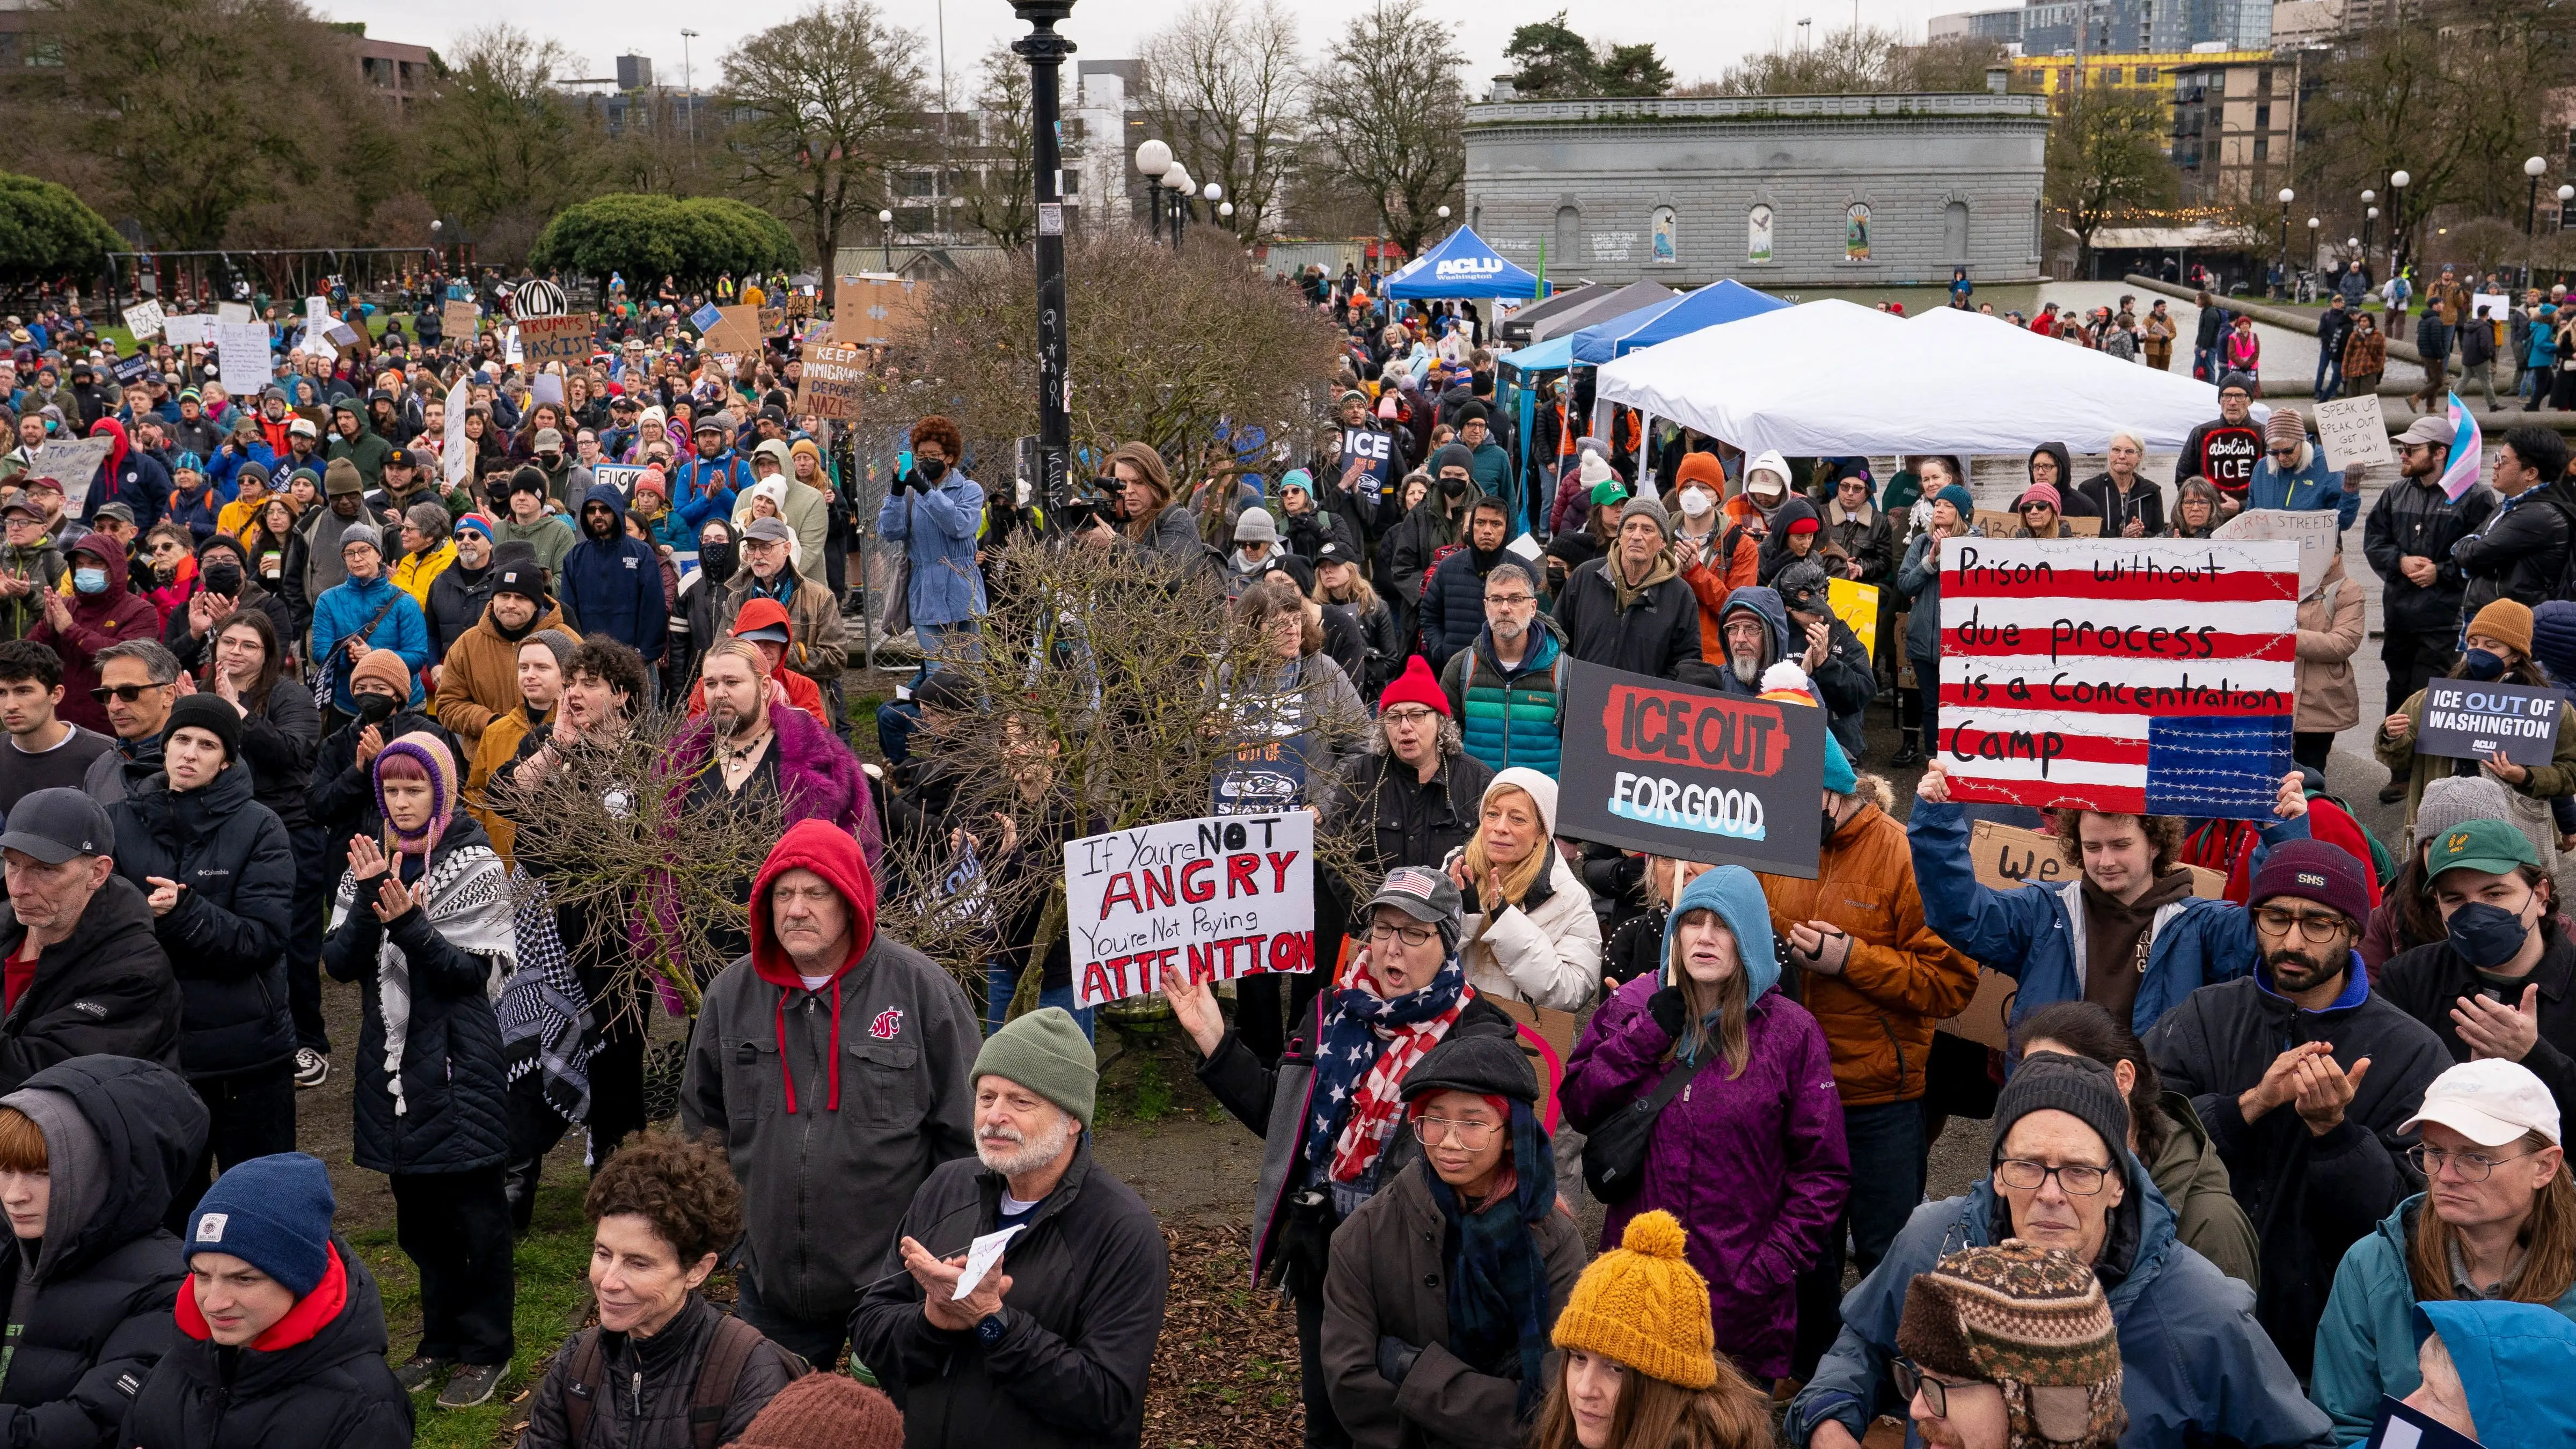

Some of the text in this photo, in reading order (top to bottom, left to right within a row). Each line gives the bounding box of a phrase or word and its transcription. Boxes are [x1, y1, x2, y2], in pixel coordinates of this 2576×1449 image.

[1436, 258, 1503, 275] ACLU
[327, 274, 345, 287] ICE
[514, 281, 565, 317] NOW
[787, 297, 810, 307] FUCK
[788, 306, 807, 316] ICE
[519, 317, 583, 334] TRUMPS
[551, 332, 558, 340] A
[522, 335, 591, 358] FASCIST
[816, 347, 856, 363] KEEP
[2322, 399, 2376, 418] SPEAK UP.
[2320, 416, 2377, 435] SPEAK OUT.
[1345, 430, 1390, 459] ICE
[2209, 437, 2255, 456] abolish
[2339, 433, 2371, 443] GET IN
[2335, 447, 2358, 457] THE
[1368, 460, 1377, 470] OF
[2214, 459, 2251, 479] ICE
[268, 464, 290, 489] UT OF
[2278, 514, 2335, 530] STREETS
[1959, 547, 2226, 587] Prison without
[1957, 603, 2217, 664] due process
[1962, 663, 1989, 701] is
[2007, 676, 2033, 700] a
[323, 688, 332, 704] OF
[2433, 690, 2555, 716] ICE OUT OF
[1620, 692, 1777, 772] ICE OUT
[2429, 711, 2550, 739] WASHINGTON
[1265, 742, 1282, 762] OF
[1951, 719, 2065, 780] Camp
[2472, 740, 2497, 750] ACLU
[1613, 771, 1765, 835] FOR GOOD
[1082, 836, 1118, 876] If
[1198, 818, 1281, 858] NOT
[1999, 845, 2060, 882] We
[1100, 850, 1299, 921] ANGRY
[2298, 874, 2324, 886] SNS
[1843, 900, 1876, 910] TITANIUM
[1152, 916, 1181, 943] Not
[1192, 906, 1258, 939] Paying
[1081, 931, 1315, 1002] ATTENTION
[87, 1002, 107, 1013] YUKON
